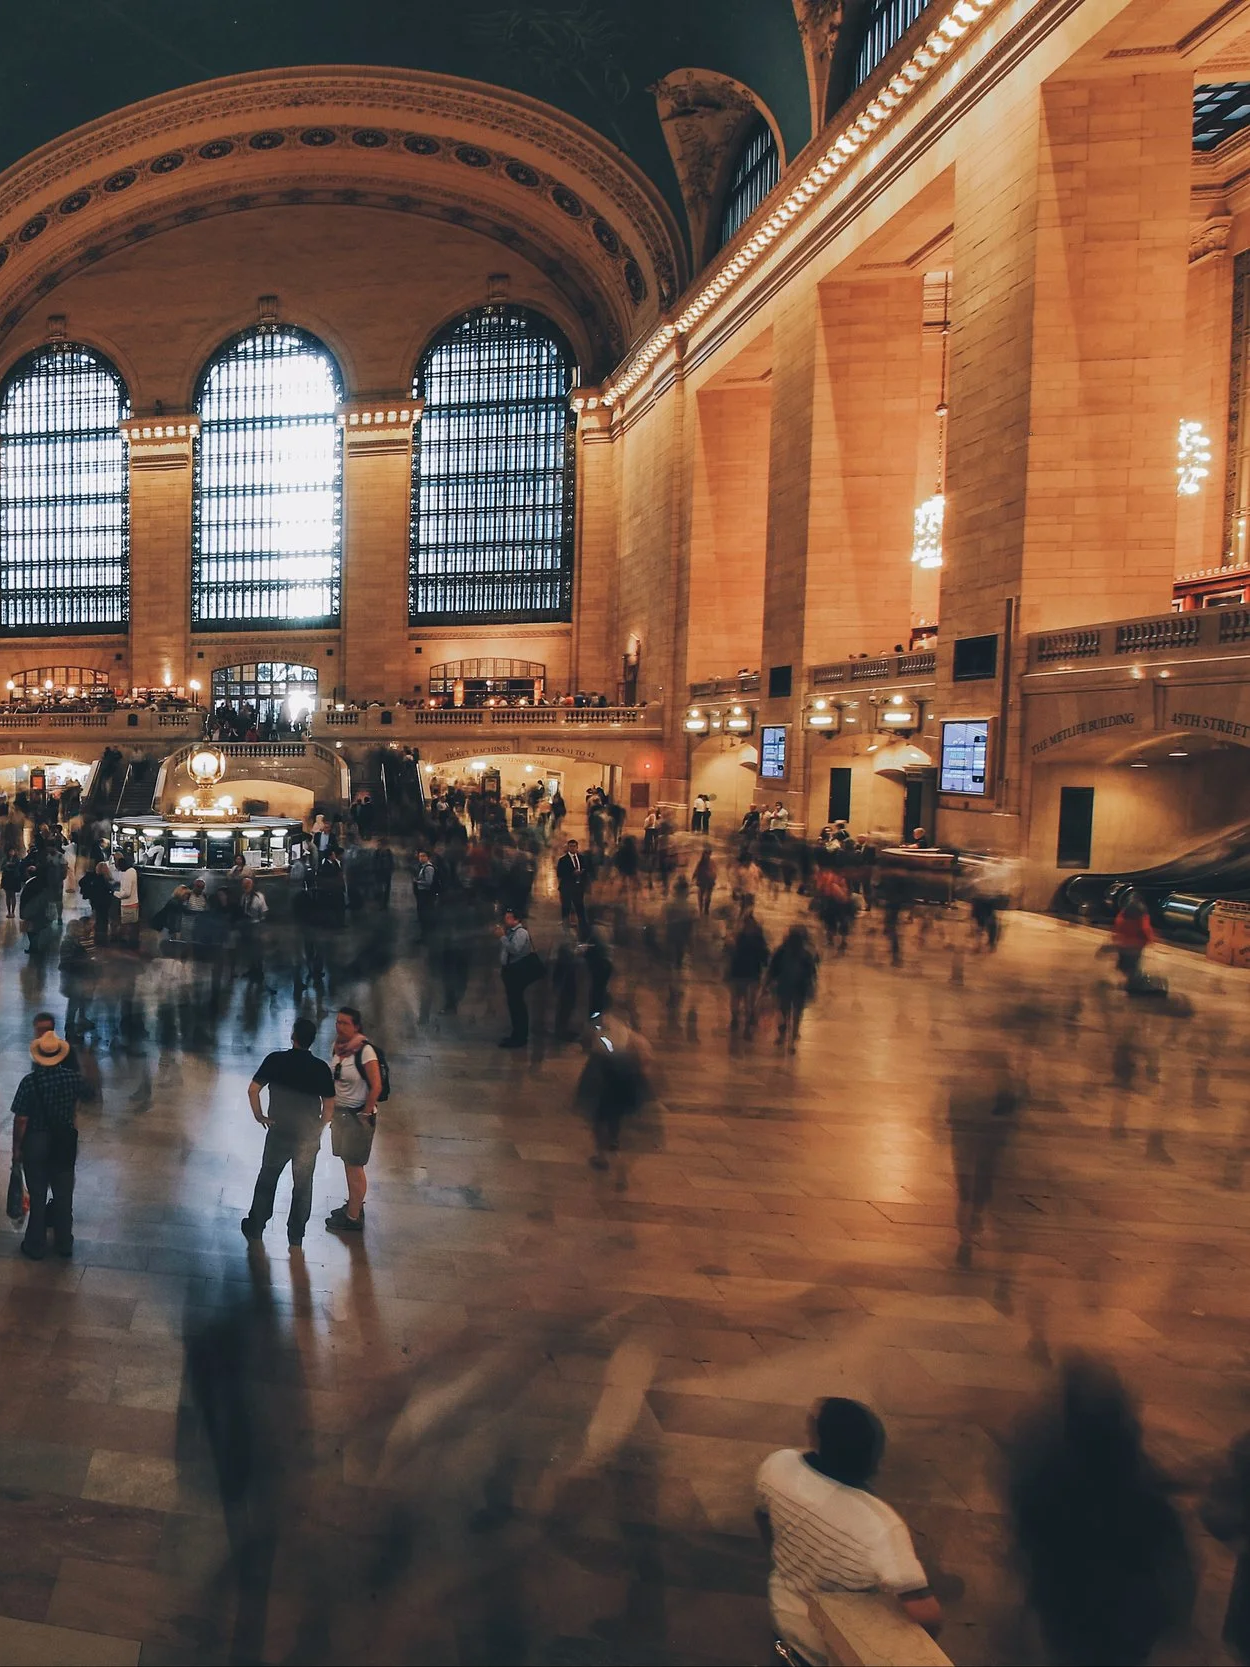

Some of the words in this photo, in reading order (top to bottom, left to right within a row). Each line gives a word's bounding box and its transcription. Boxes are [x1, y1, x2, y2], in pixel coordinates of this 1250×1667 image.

[1031, 738, 1050, 756] THE
[1049, 722, 1088, 746] METLIFE
[1088, 712, 1136, 734] BUILDING
[1171, 712, 1201, 728] 45TH
[1202, 716, 1250, 738] STREET
[445, 750, 470, 760] TICKET
[472, 745, 511, 754] MACHINES
[536, 746, 565, 754] TRACKS
[576, 748, 587, 756] TO
